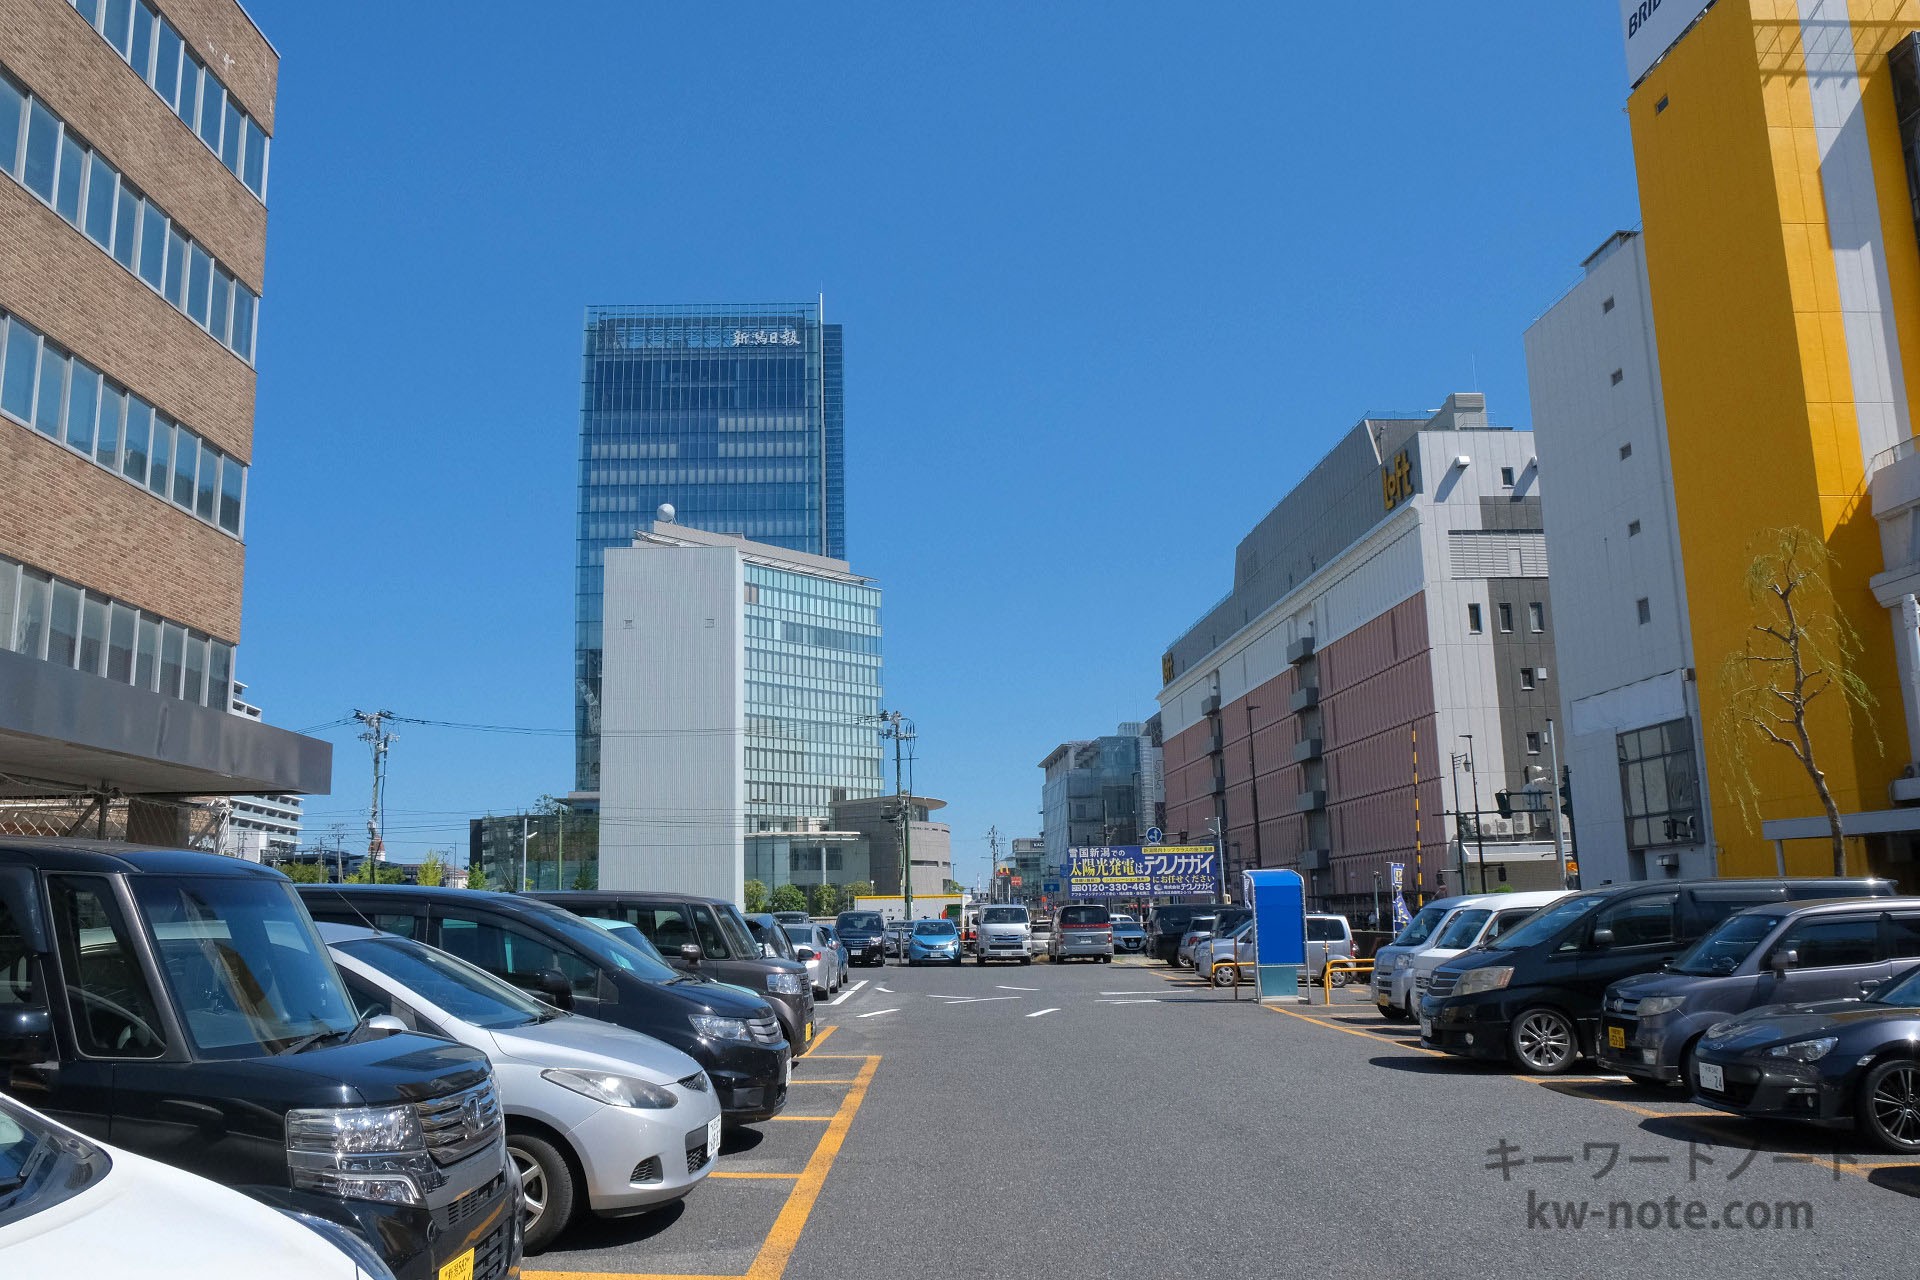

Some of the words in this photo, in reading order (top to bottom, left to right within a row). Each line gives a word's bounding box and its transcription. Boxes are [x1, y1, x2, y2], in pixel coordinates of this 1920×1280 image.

[732, 328, 801, 346] 新潟日報
[1068, 847, 1126, 858] 雪国新潟での
[1069, 857, 1144, 877] 太陽光発電は
[1144, 855, 1214, 875] テクノナガイ
[1153, 875, 1215, 883] にお任せください
[1081, 883, 1151, 892] 0120-330-463
